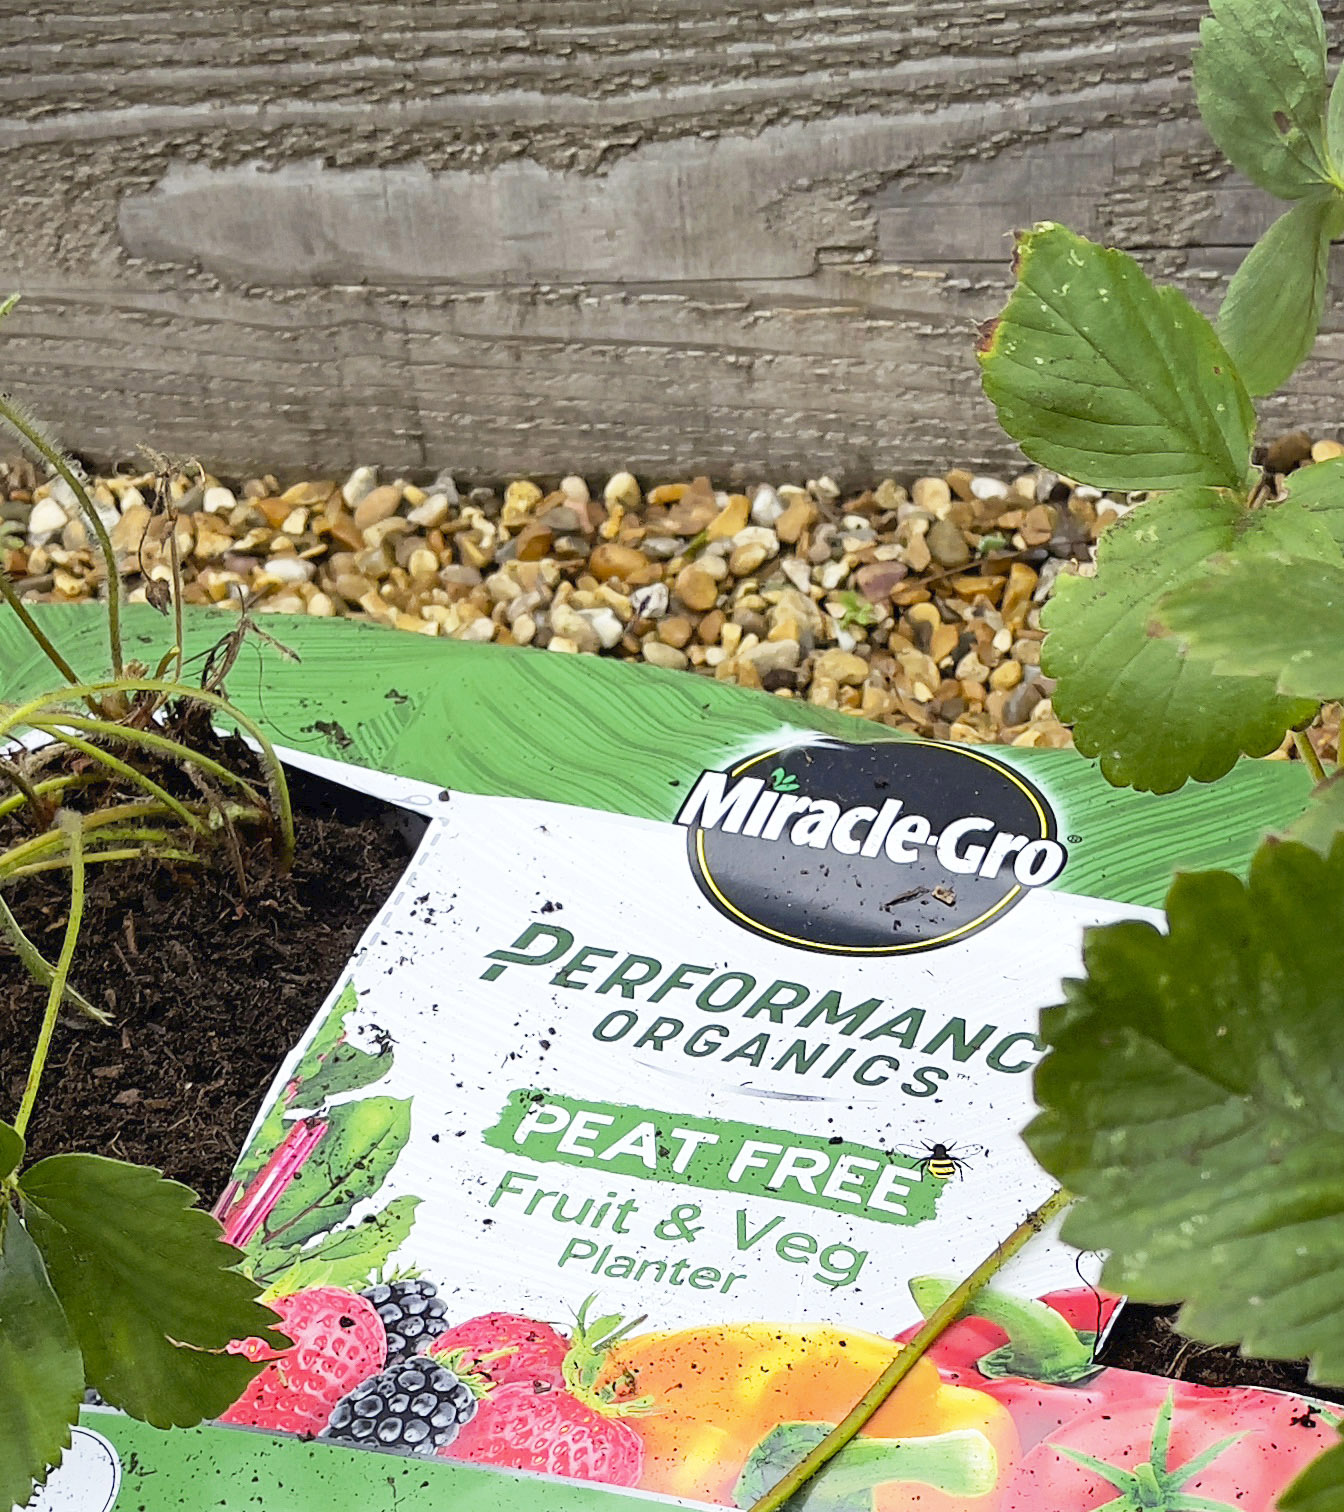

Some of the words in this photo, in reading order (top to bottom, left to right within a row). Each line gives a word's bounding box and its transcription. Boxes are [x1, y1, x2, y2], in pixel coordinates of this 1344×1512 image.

[678, 770, 1063, 887] Miracle-Gro
[479, 922, 1052, 1074] PERFORMANC
[512, 1101, 720, 1178] PEAT
[729, 1140, 922, 1218] FREE
[488, 1170, 637, 1236] Fruit
[654, 1204, 706, 1244] &
[734, 1208, 869, 1287] Veg
[558, 1238, 747, 1296] Planter
